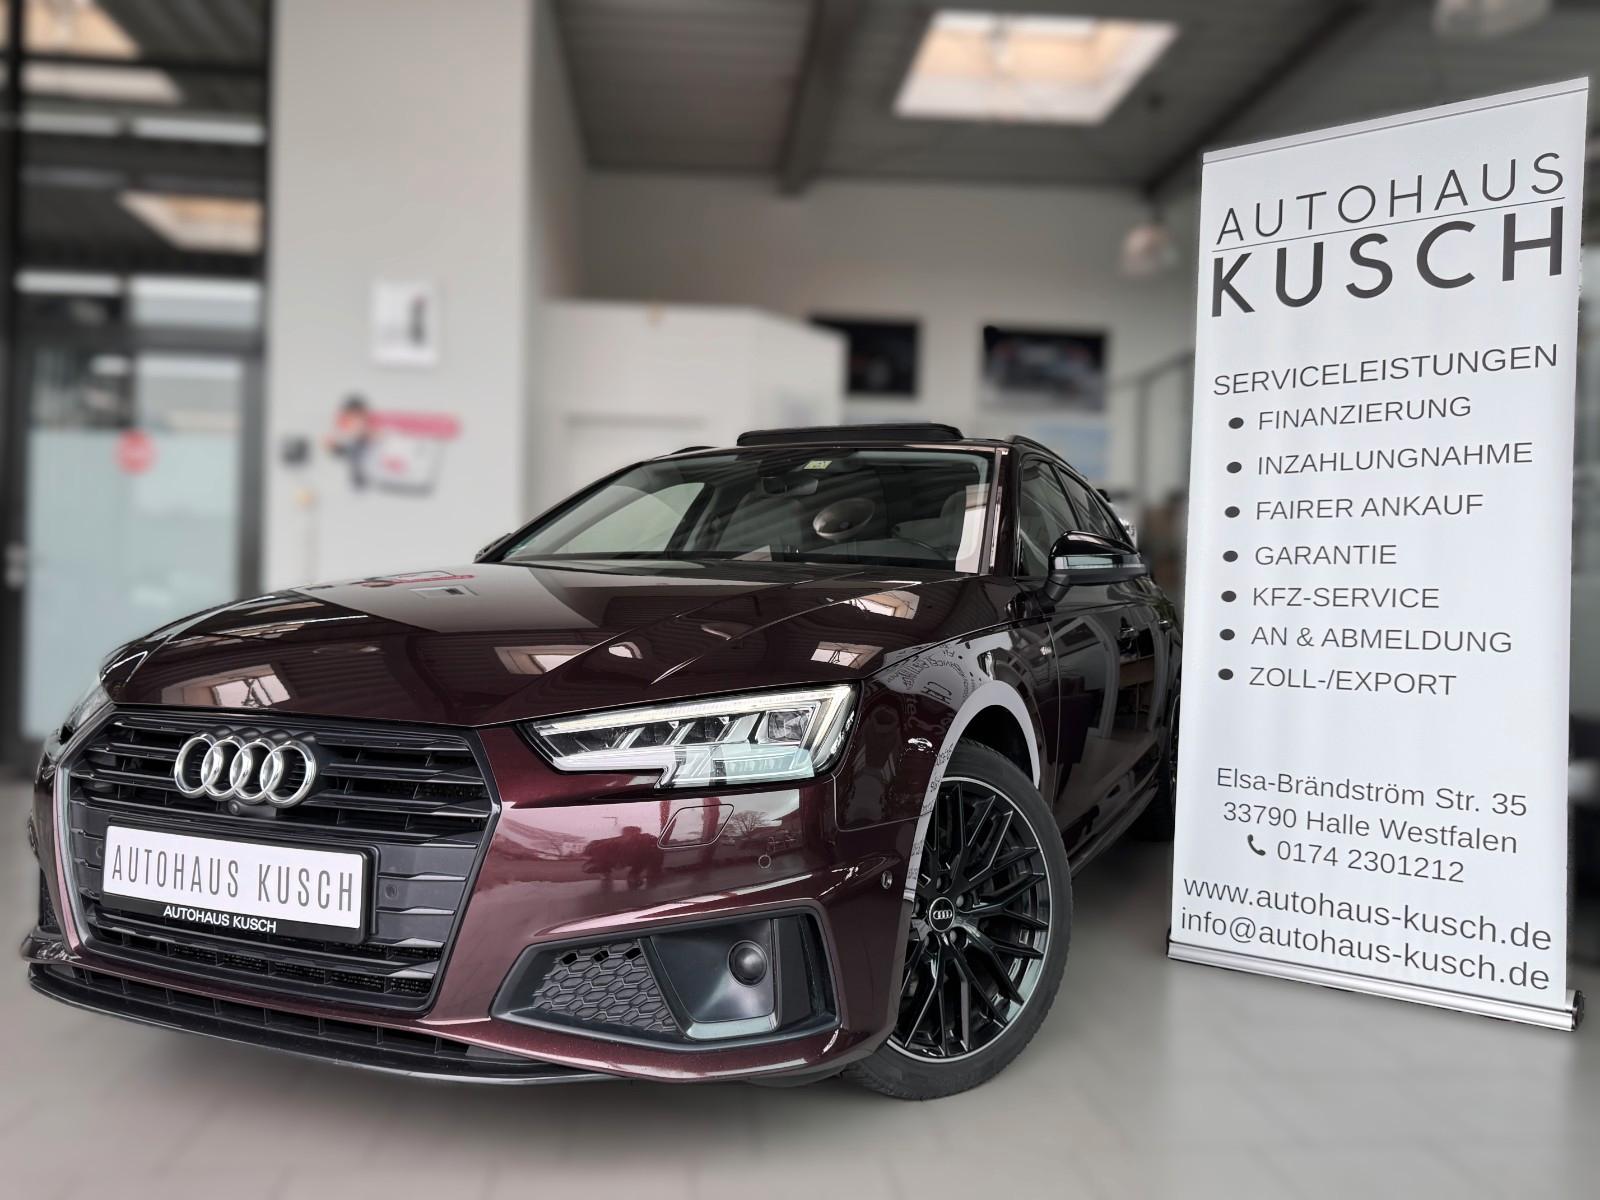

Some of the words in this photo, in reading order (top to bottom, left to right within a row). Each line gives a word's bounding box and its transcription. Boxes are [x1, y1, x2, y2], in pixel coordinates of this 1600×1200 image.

[1216, 152, 1564, 245] AUTOHAUS
[1211, 205, 1564, 318] KUSCH
[1213, 343, 1557, 396] SERVICELEISTUNGEN
[1258, 396, 1471, 431] FINANZIERUNG
[1258, 442, 1533, 475] INZAHLUNGNAHME
[1256, 498, 1353, 520] FAIRER
[1360, 494, 1484, 518] ANKAUF
[1255, 544, 1397, 566] GARANTIE
[1253, 587, 1440, 608] KFZ-SERVICE
[1250, 626, 1288, 646] AN
[1296, 627, 1315, 647] &
[1320, 628, 1512, 653] ABMELDUNG
[1249, 666, 1457, 696] ZOLL-/EXPORT
[1217, 767, 1424, 807] Elsa-Brändström
[1435, 787, 1480, 813] Str.
[1491, 792, 1527, 817] 35
[1223, 801, 1297, 829] 33790
[1306, 810, 1370, 838] Halle
[1379, 818, 1517, 854] Westfalen
[112, 844, 239, 898] AUTOHAUS
[257, 863, 352, 912] KUSCH
[1277, 840, 1339, 867] 0174
[1347, 849, 1464, 883] 2301212
[163, 905, 230, 927] AUTOHAUS
[232, 915, 277, 934] KUSCH
[1183, 878, 1552, 951] www.autohaus-kusch.de
[1181, 906, 1550, 990] info@autohaus-kusch.de
